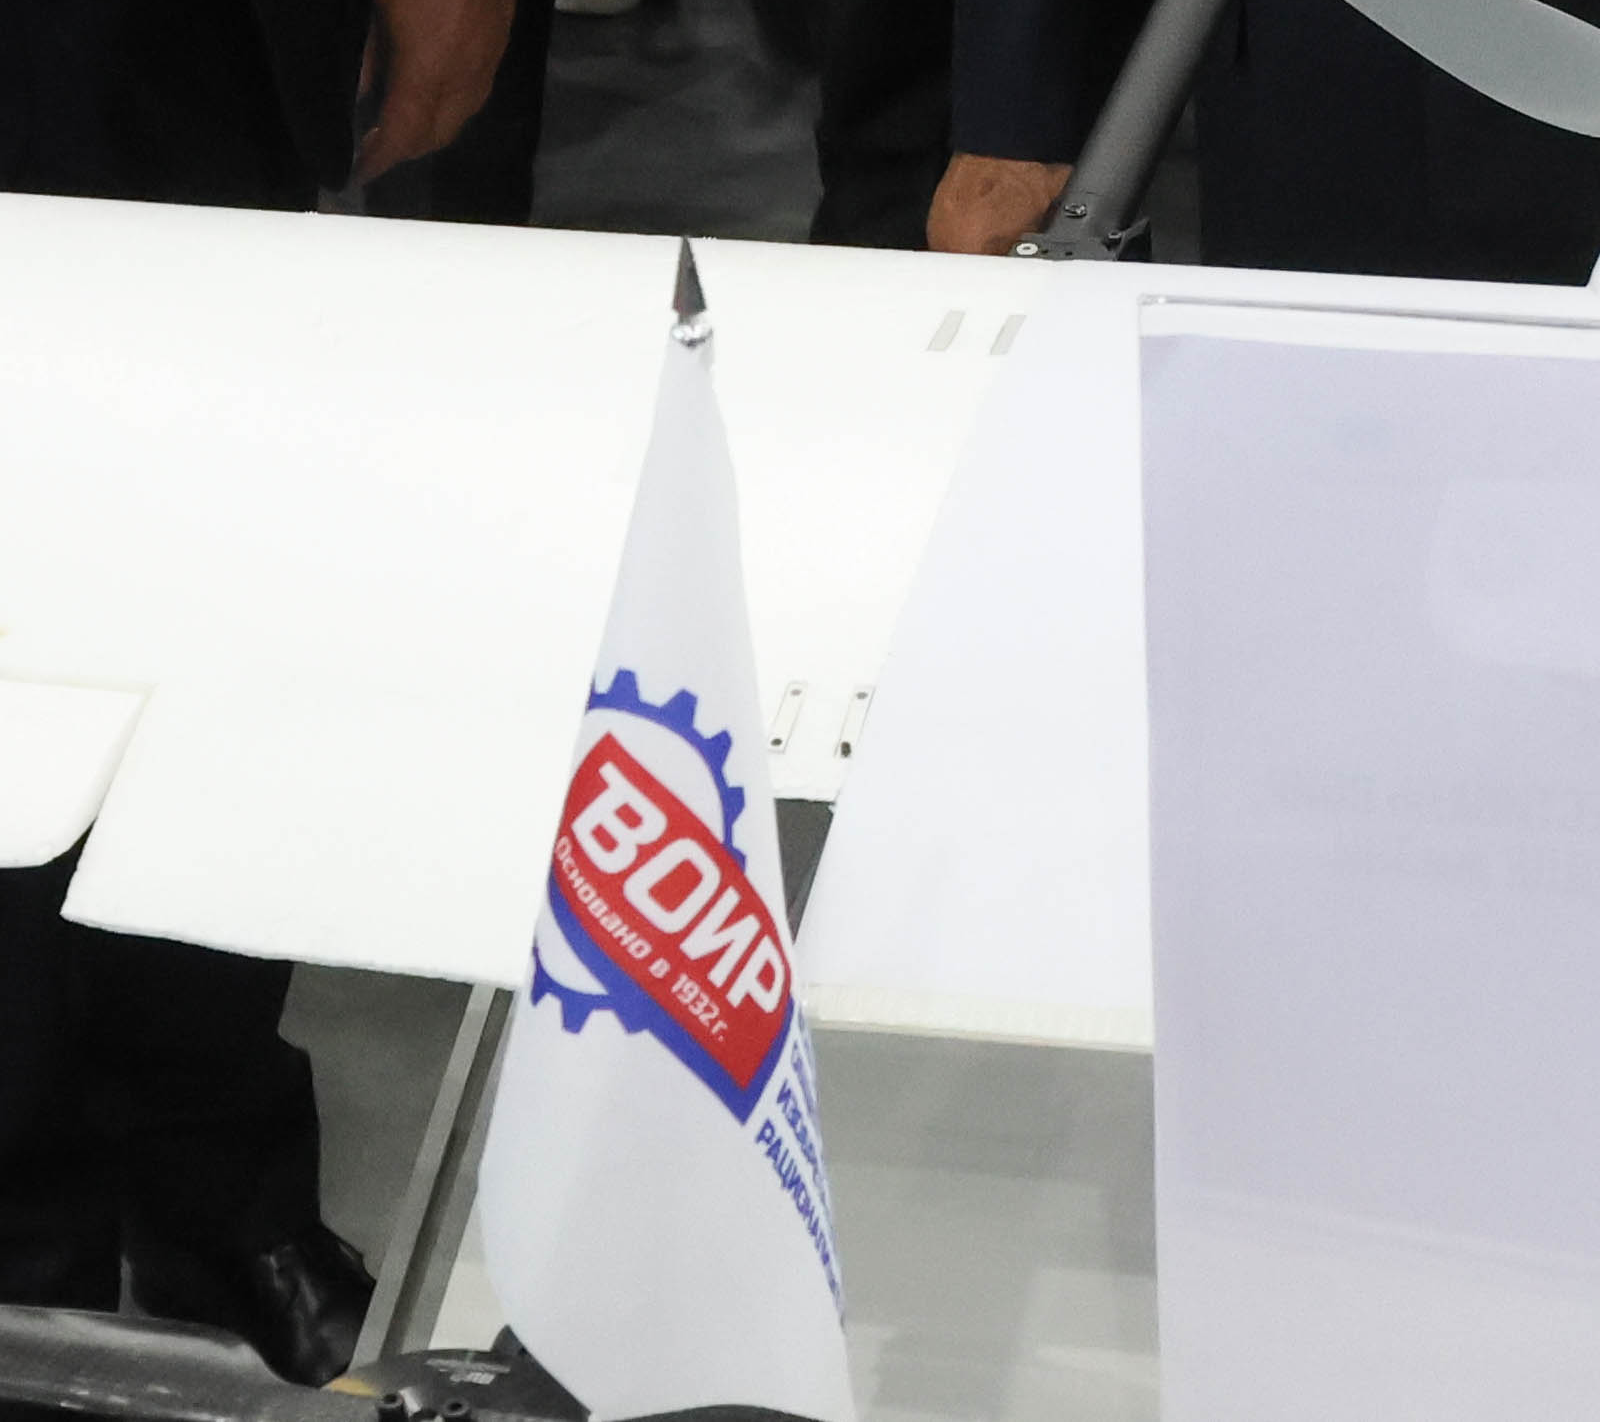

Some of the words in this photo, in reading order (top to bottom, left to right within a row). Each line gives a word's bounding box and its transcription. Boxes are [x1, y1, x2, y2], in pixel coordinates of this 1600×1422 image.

[554, 835, 653, 960] Основано
[648, 957, 672, 980] в
[571, 760, 787, 1014] ВОИР
